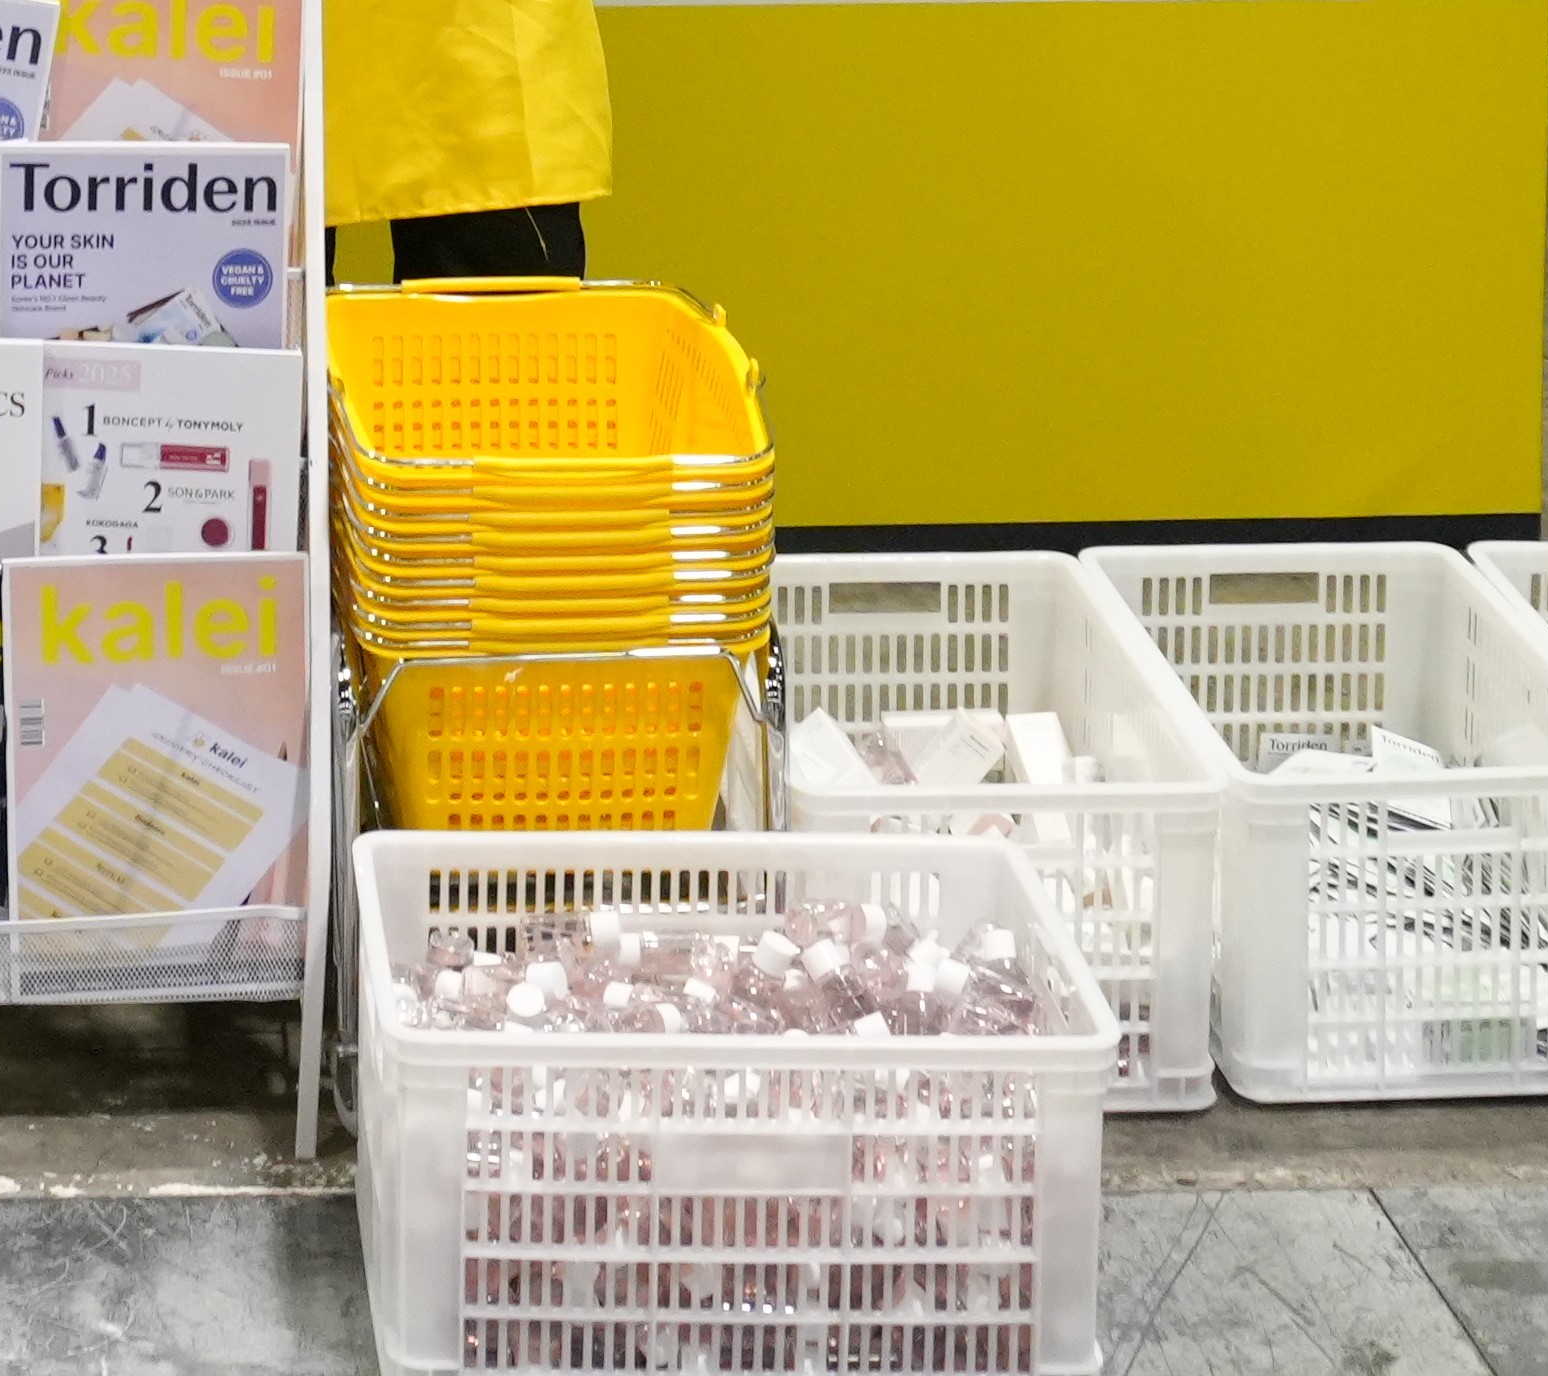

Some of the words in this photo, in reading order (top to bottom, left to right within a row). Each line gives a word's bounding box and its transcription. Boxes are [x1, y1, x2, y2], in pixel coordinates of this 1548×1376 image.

[9, 161, 278, 214] Torriden
[11, 234, 65, 249] YOUR
[70, 233, 115, 249] SKIN
[11, 253, 28, 270] IS
[33, 253, 74, 269] OUR
[11, 273, 86, 289] PLANET
[44, 367, 75, 382] Picks
[78, 362, 133, 384] 2025
[82, 403, 97, 437] 1
[176, 418, 244, 433] TONYMOLY
[142, 480, 164, 514] 2
[167, 487, 236, 501] SON&PARK
[38, 574, 278, 666] kalei
